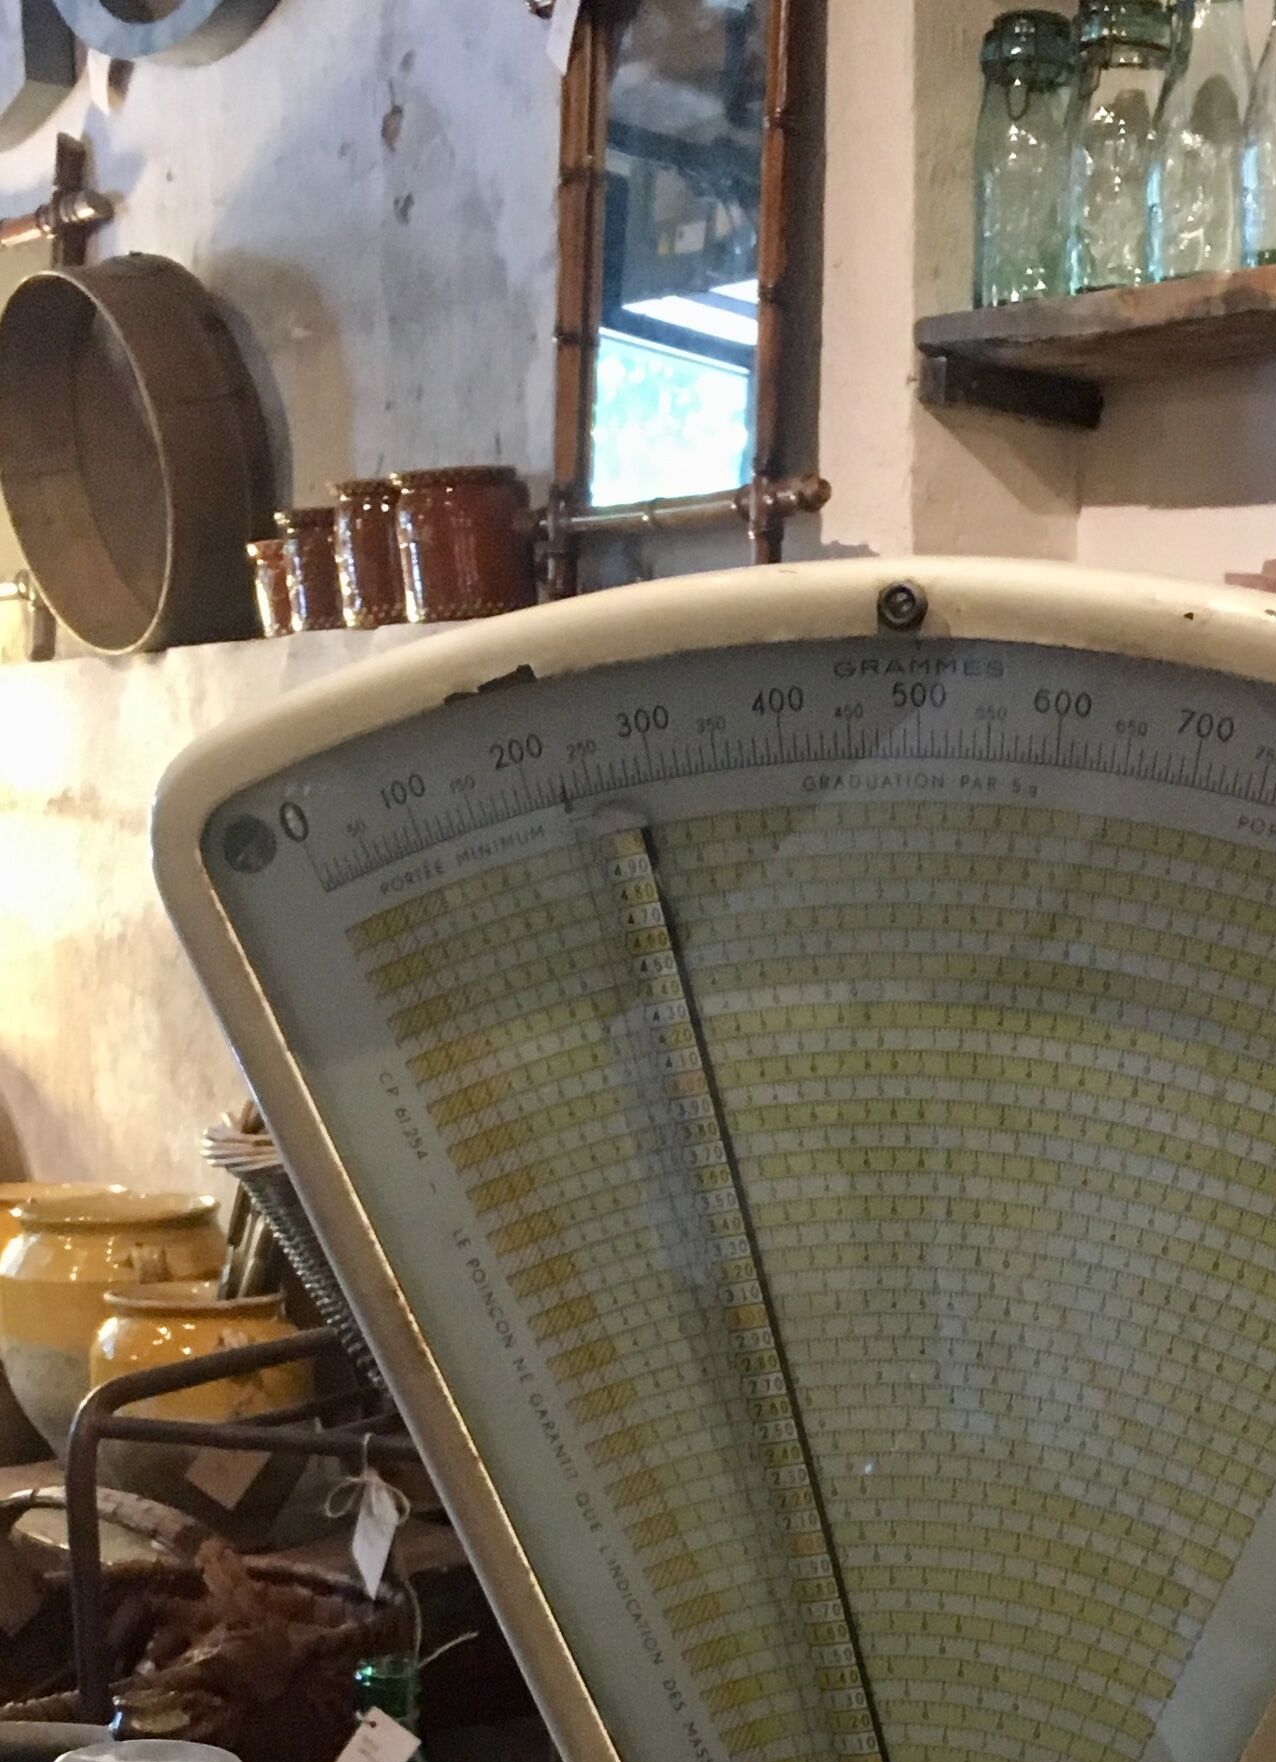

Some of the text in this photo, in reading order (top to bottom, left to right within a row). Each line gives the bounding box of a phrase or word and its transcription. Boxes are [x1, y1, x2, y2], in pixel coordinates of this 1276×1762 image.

[833, 658, 1005, 680] GRAMMES
[751, 685, 805, 714] 400
[891, 681, 947, 708] 500
[1033, 689, 1093, 718] 600
[616, 705, 670, 739] 300
[1177, 709, 1236, 743] 700
[489, 733, 544, 771] 200
[381, 773, 427, 811] 100
[801, 772, 946, 794] GRADUATION
[960, 773, 998, 792] PAR
[278, 800, 310, 843] 0
[455, 823, 546, 867] MINIMUM
[451, 1226, 472, 1251] LE
[512, 1356, 534, 1384] NE
[575, 1491, 603, 1534] QUE
[662, 1679, 685, 1713] DES
